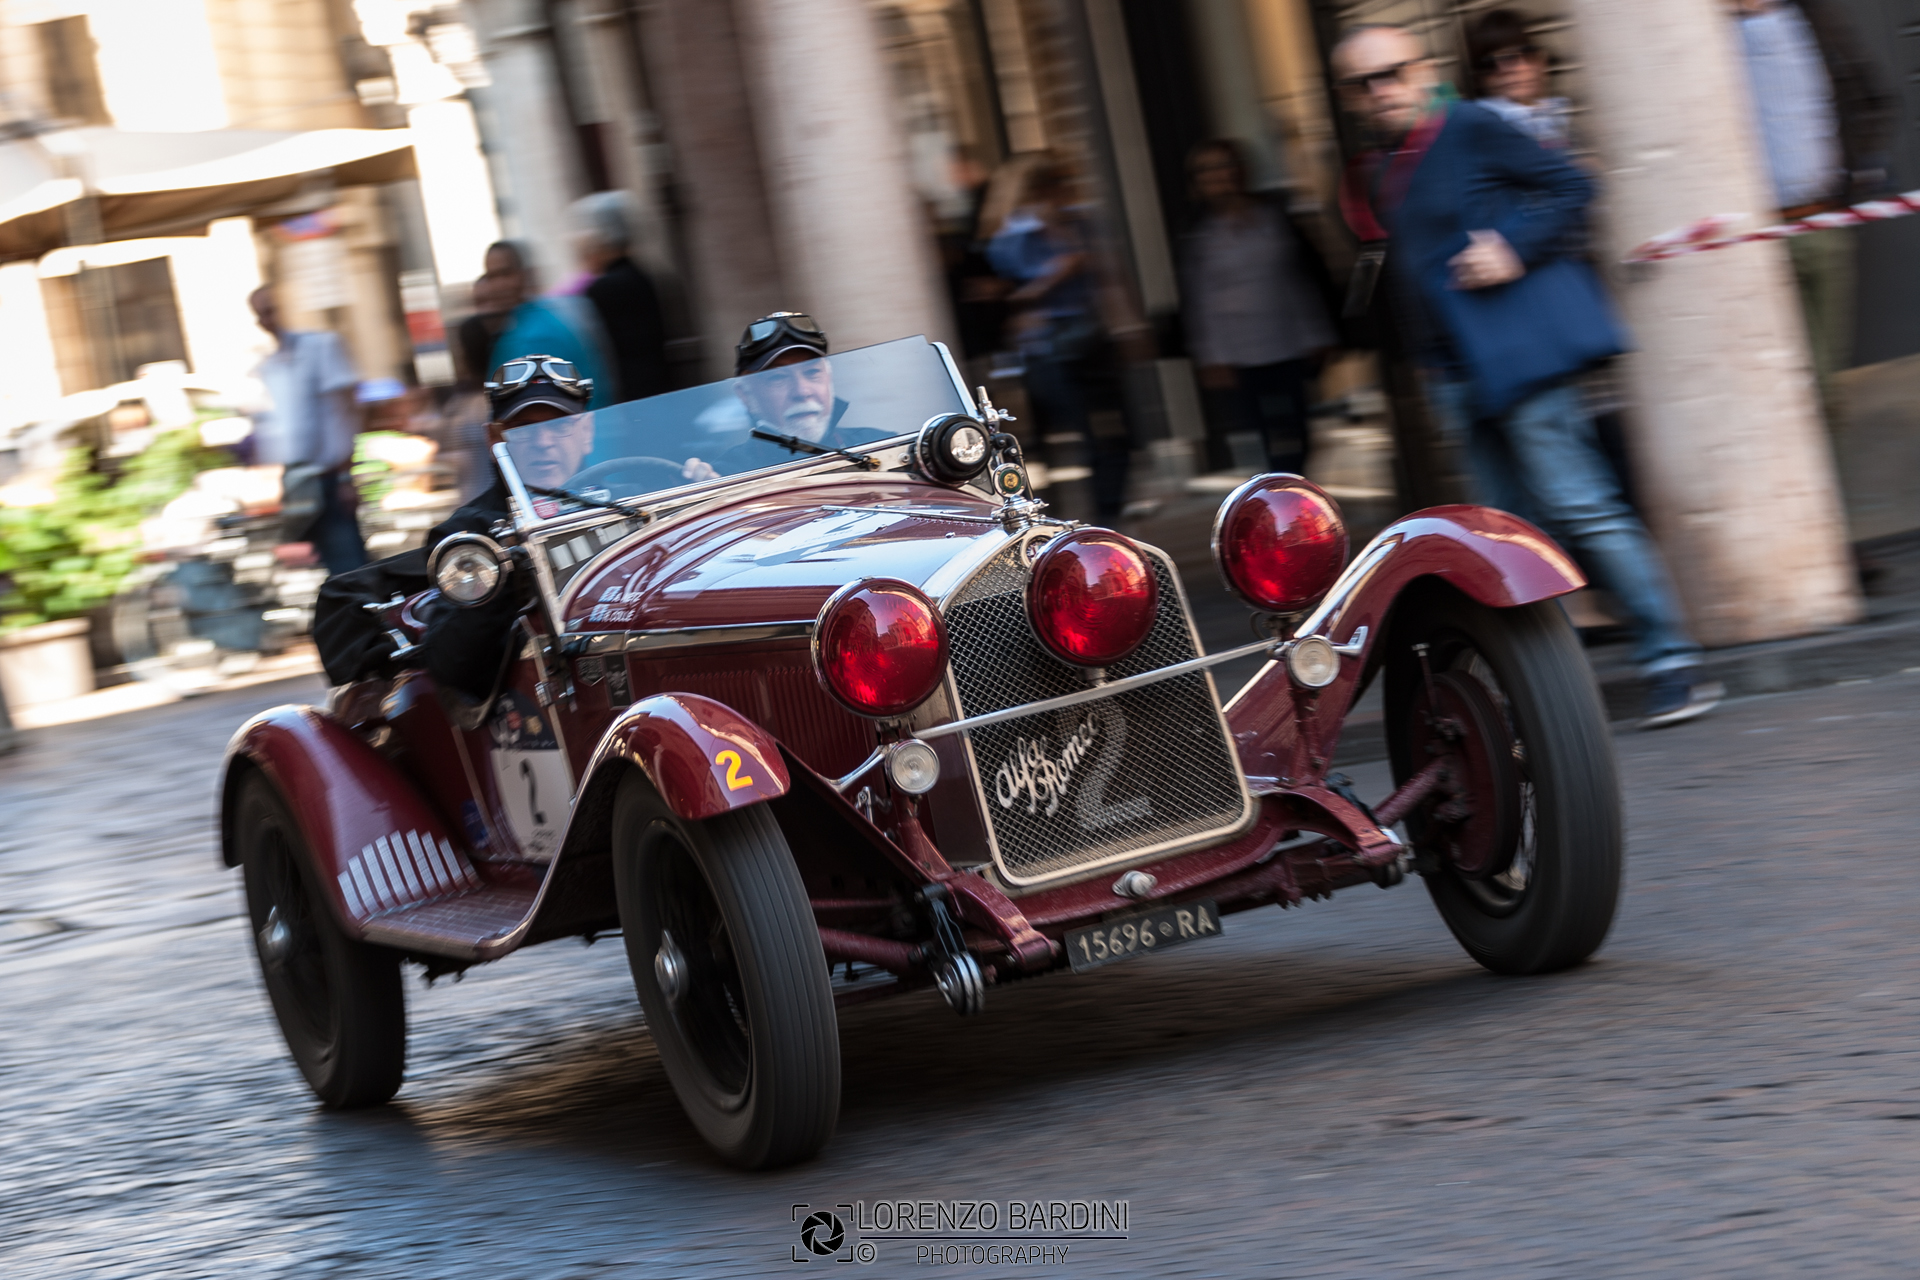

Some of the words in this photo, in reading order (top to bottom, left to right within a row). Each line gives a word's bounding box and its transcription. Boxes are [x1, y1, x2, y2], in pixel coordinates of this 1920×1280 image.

[519, 757, 549, 827] 2
[715, 750, 753, 791] 2
[996, 736, 1044, 814] Alfa
[1032, 712, 1100, 817] Romeo
[1079, 918, 1156, 963] 15696
[1175, 904, 1216, 939] RA
